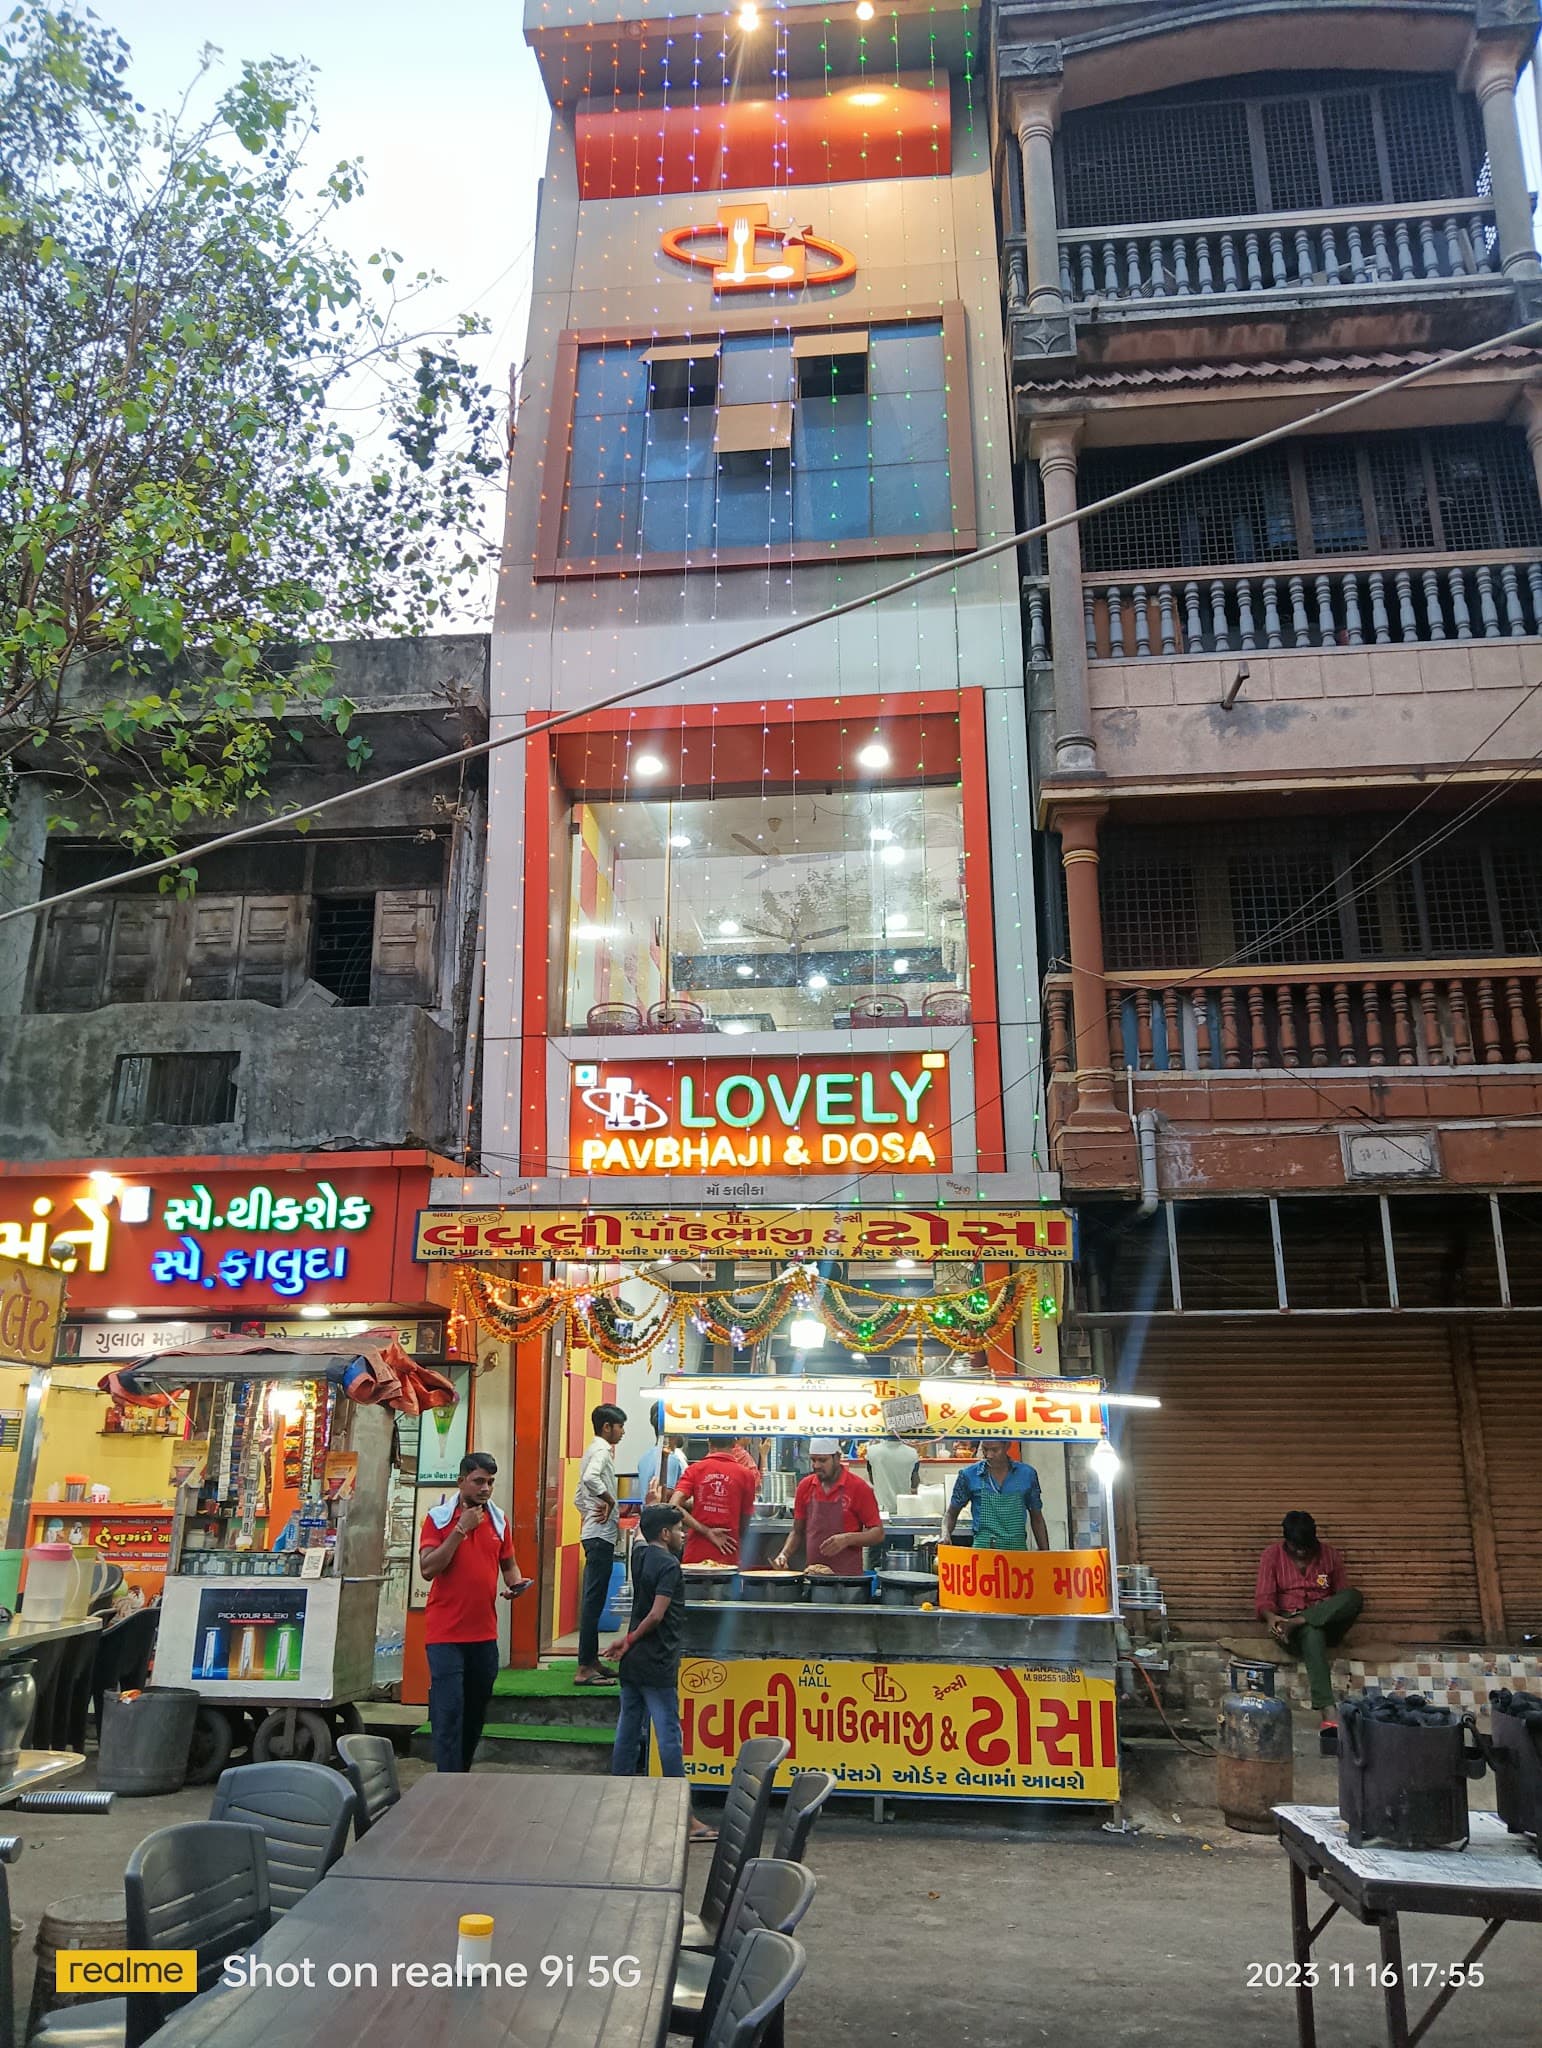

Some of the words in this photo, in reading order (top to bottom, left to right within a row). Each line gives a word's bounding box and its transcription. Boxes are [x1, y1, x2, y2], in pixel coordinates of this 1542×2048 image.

[680, 1070, 932, 1129] LOVELY
[582, 1134, 771, 1169] PAVBHAJI
[783, 1135, 811, 1166] &
[822, 1131, 936, 1165] DOSA
[423, 1214, 621, 1247] લવલી
[823, 1229, 849, 1244] &
[858, 1212, 1067, 1246] ઢોસા
[96, 1332, 146, 1353] ગુલાબ
[941, 1554, 1034, 1600] ચાઈનીઝ
[799, 1676, 831, 1688] HALL
[802, 1664, 825, 1675] A/C
[940, 1715, 960, 1753] &
[965, 1666, 1117, 1768] ઢોસા
[892, 1764, 947, 1785] ઓર્ડર
[955, 1766, 1016, 1787] લેવામાં
[1022, 1770, 1085, 1790] આવશે
